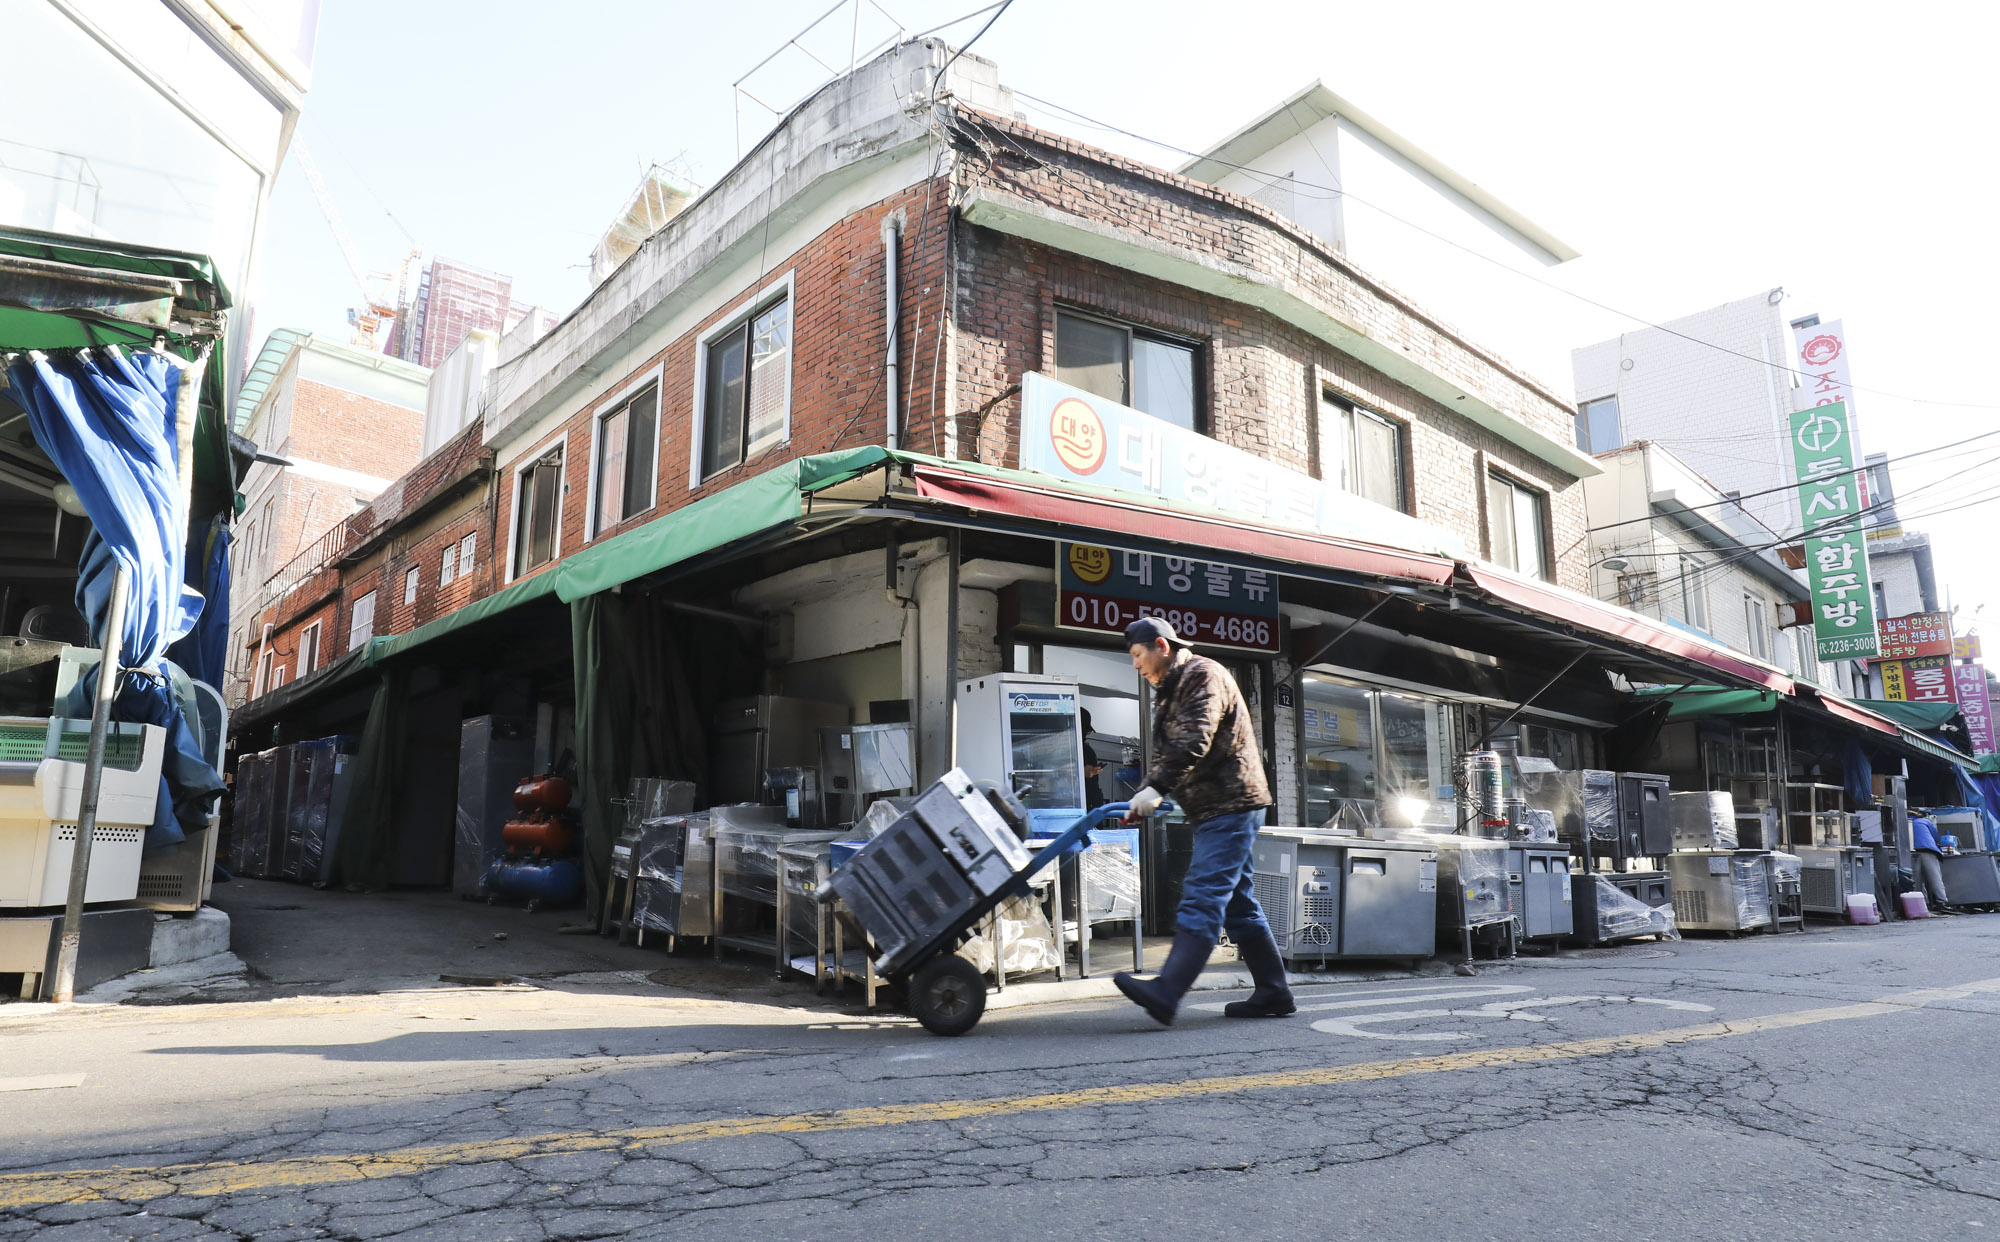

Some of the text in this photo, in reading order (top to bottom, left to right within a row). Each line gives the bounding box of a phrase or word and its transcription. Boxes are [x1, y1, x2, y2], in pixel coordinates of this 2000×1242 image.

[1061, 415, 1096, 438] 대양
[1800, 456, 1864, 628] 동서종합주방
[1076, 547, 1105, 562] 대양
[1123, 550, 1270, 602] 대양물류
[1879, 628, 1947, 646] 러드바.전문용품
[1884, 665, 1902, 700] 주방설비
[1911, 668, 1949, 703] 중고
[1016, 700, 1049, 708] FREETOP
[1282, 694, 1290, 705] 12
